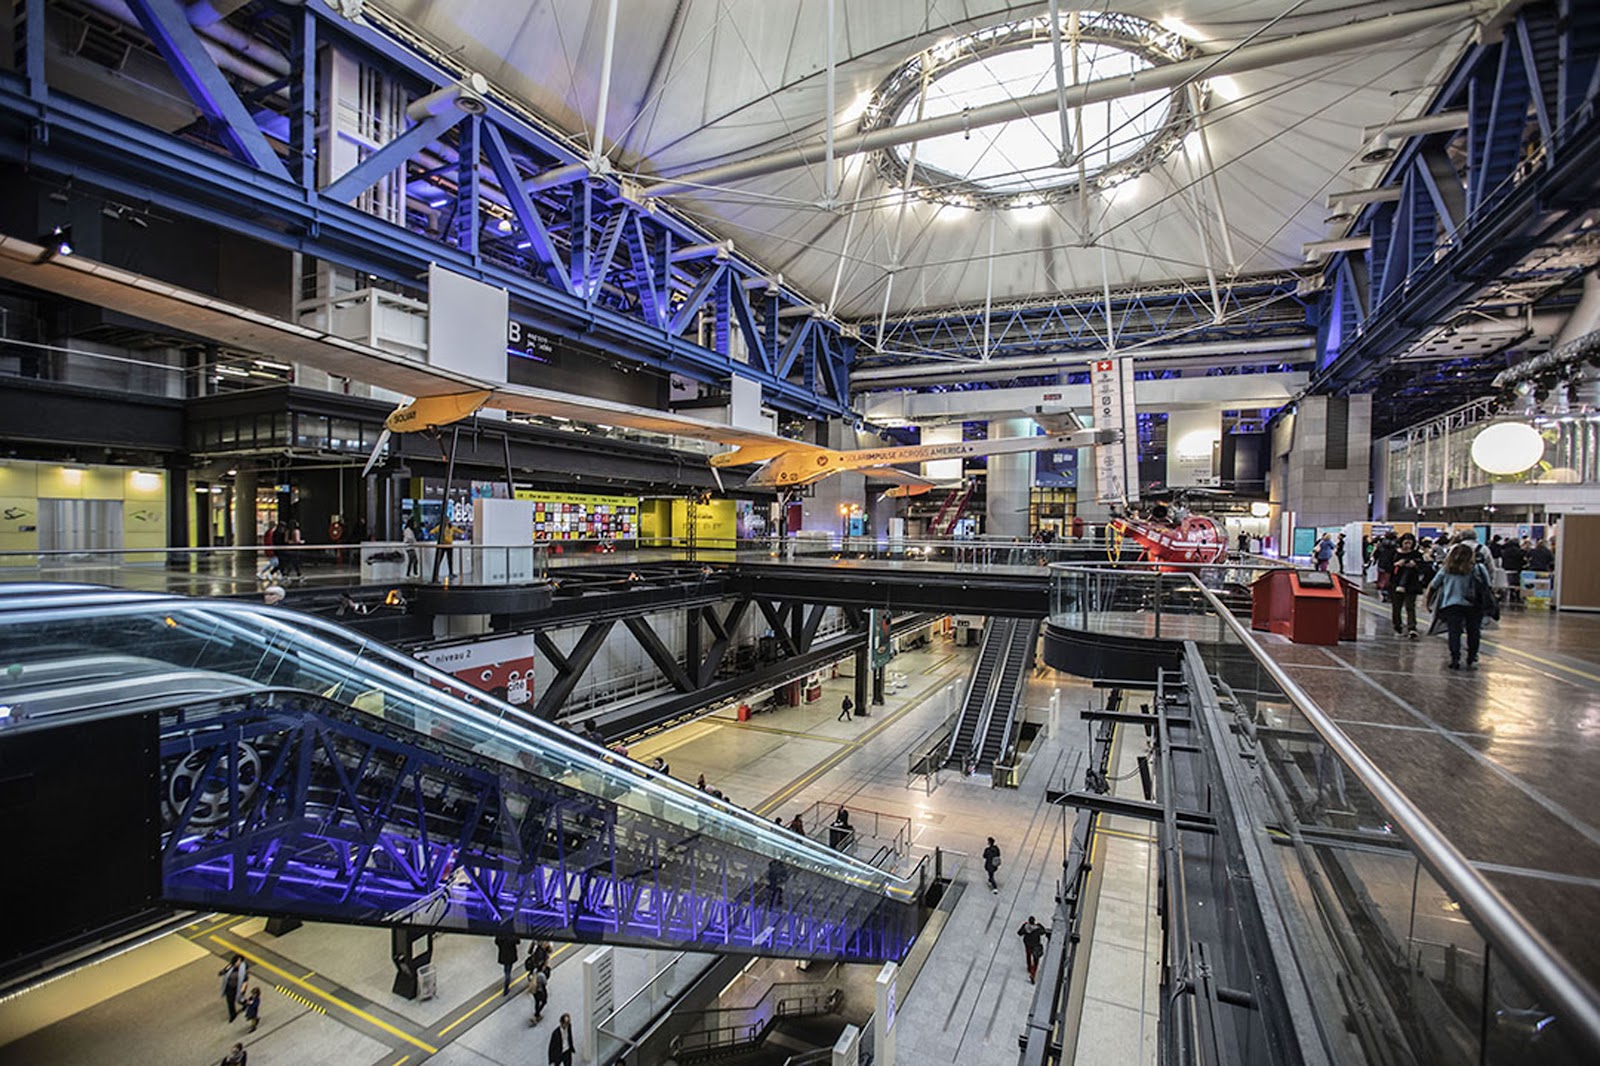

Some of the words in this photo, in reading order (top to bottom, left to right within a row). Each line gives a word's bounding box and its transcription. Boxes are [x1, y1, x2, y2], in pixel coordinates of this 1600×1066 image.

[899, 447, 928, 459] ACROSS
[930, 445, 967, 456] AMERICA
[435, 652, 464, 663] niveau
[466, 649, 472, 658] 2
